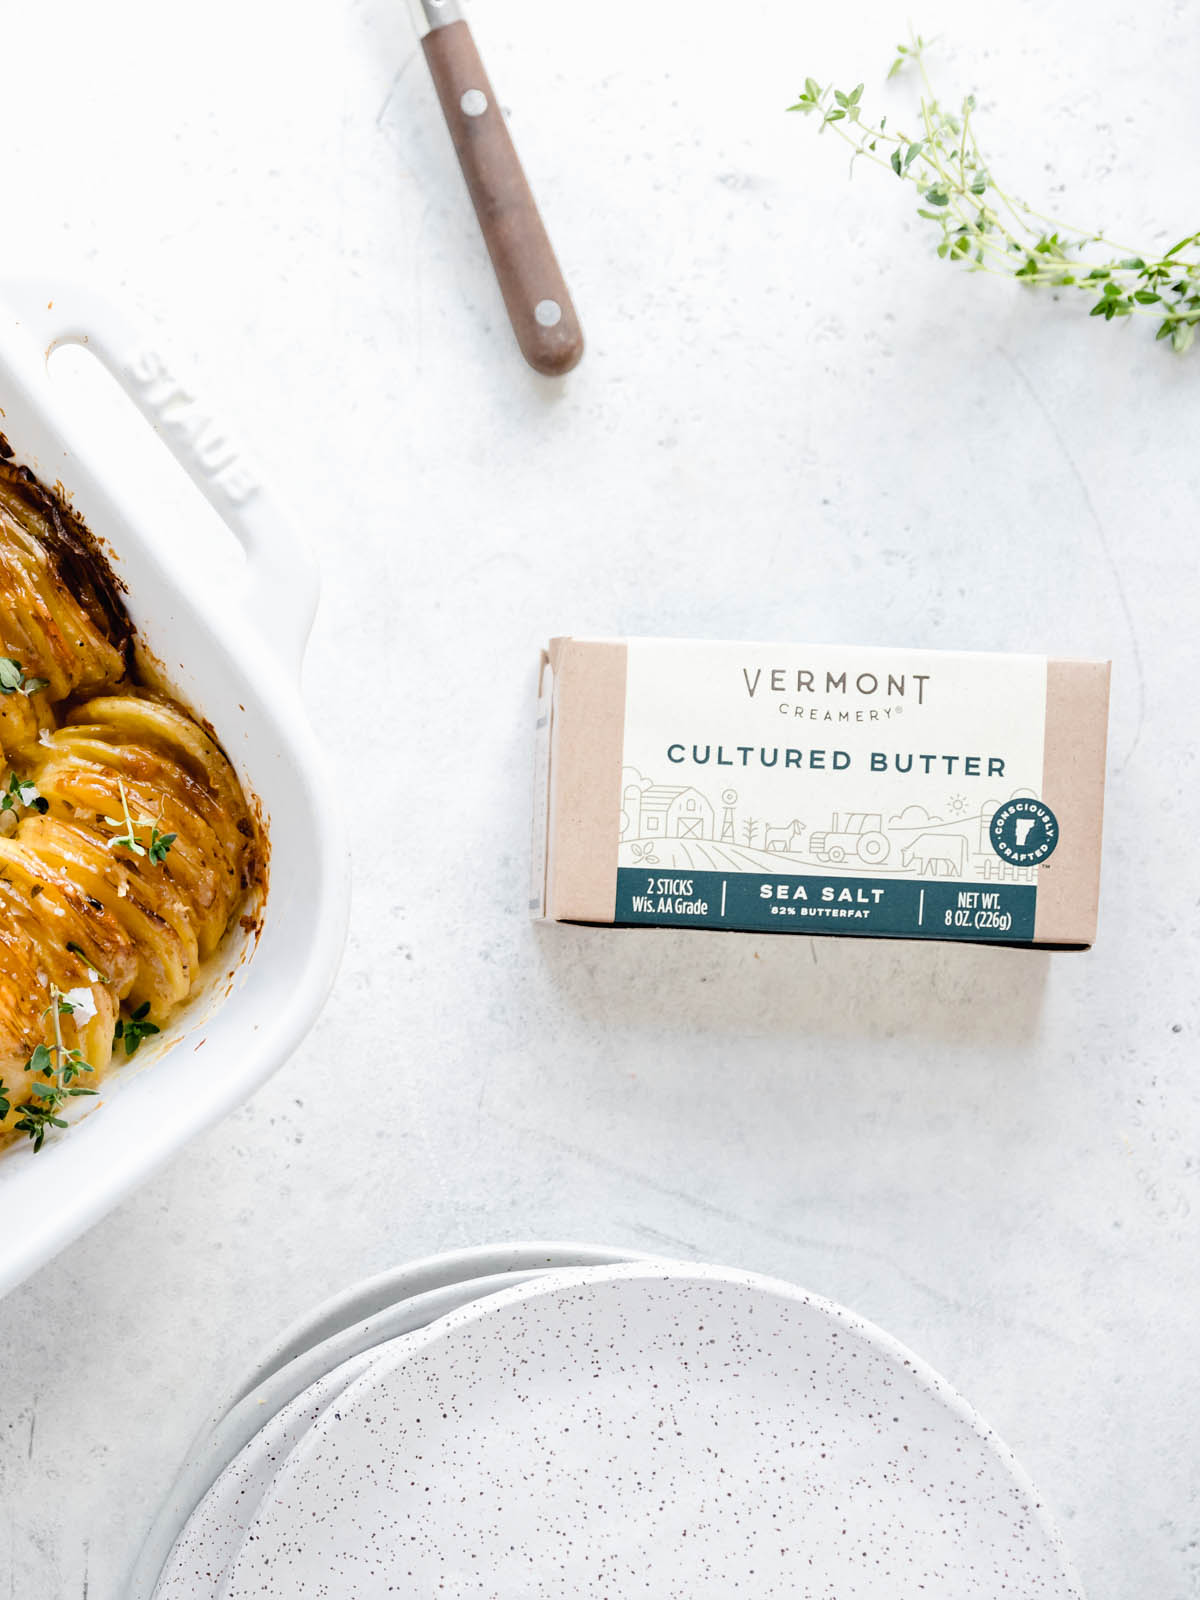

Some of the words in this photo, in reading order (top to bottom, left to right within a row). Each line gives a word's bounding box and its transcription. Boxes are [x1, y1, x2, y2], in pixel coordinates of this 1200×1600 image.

[742, 667, 931, 705] VERMONT
[666, 743, 851, 770] CULTURED
[870, 752, 1006, 778] BUTTER
[994, 803, 1054, 838] CONSCIOUSLY
[998, 842, 1049, 862] CRAFTED
[646, 878, 654, 895] 2
[656, 879, 694, 896] STICKS
[759, 884, 809, 901] SEA
[820, 886, 885, 904] SALT
[632, 896, 656, 913] Wis.
[657, 898, 673, 914] AA
[674, 898, 708, 916] Grade
[957, 891, 980, 909] NET
[981, 893, 1001, 911] WT.
[770, 906, 797, 916] 82%
[800, 907, 871, 919] BUTTERFAT
[944, 909, 952, 926] 8
[954, 910, 972, 927] OZ.
[974, 911, 1012, 931] (226g)
